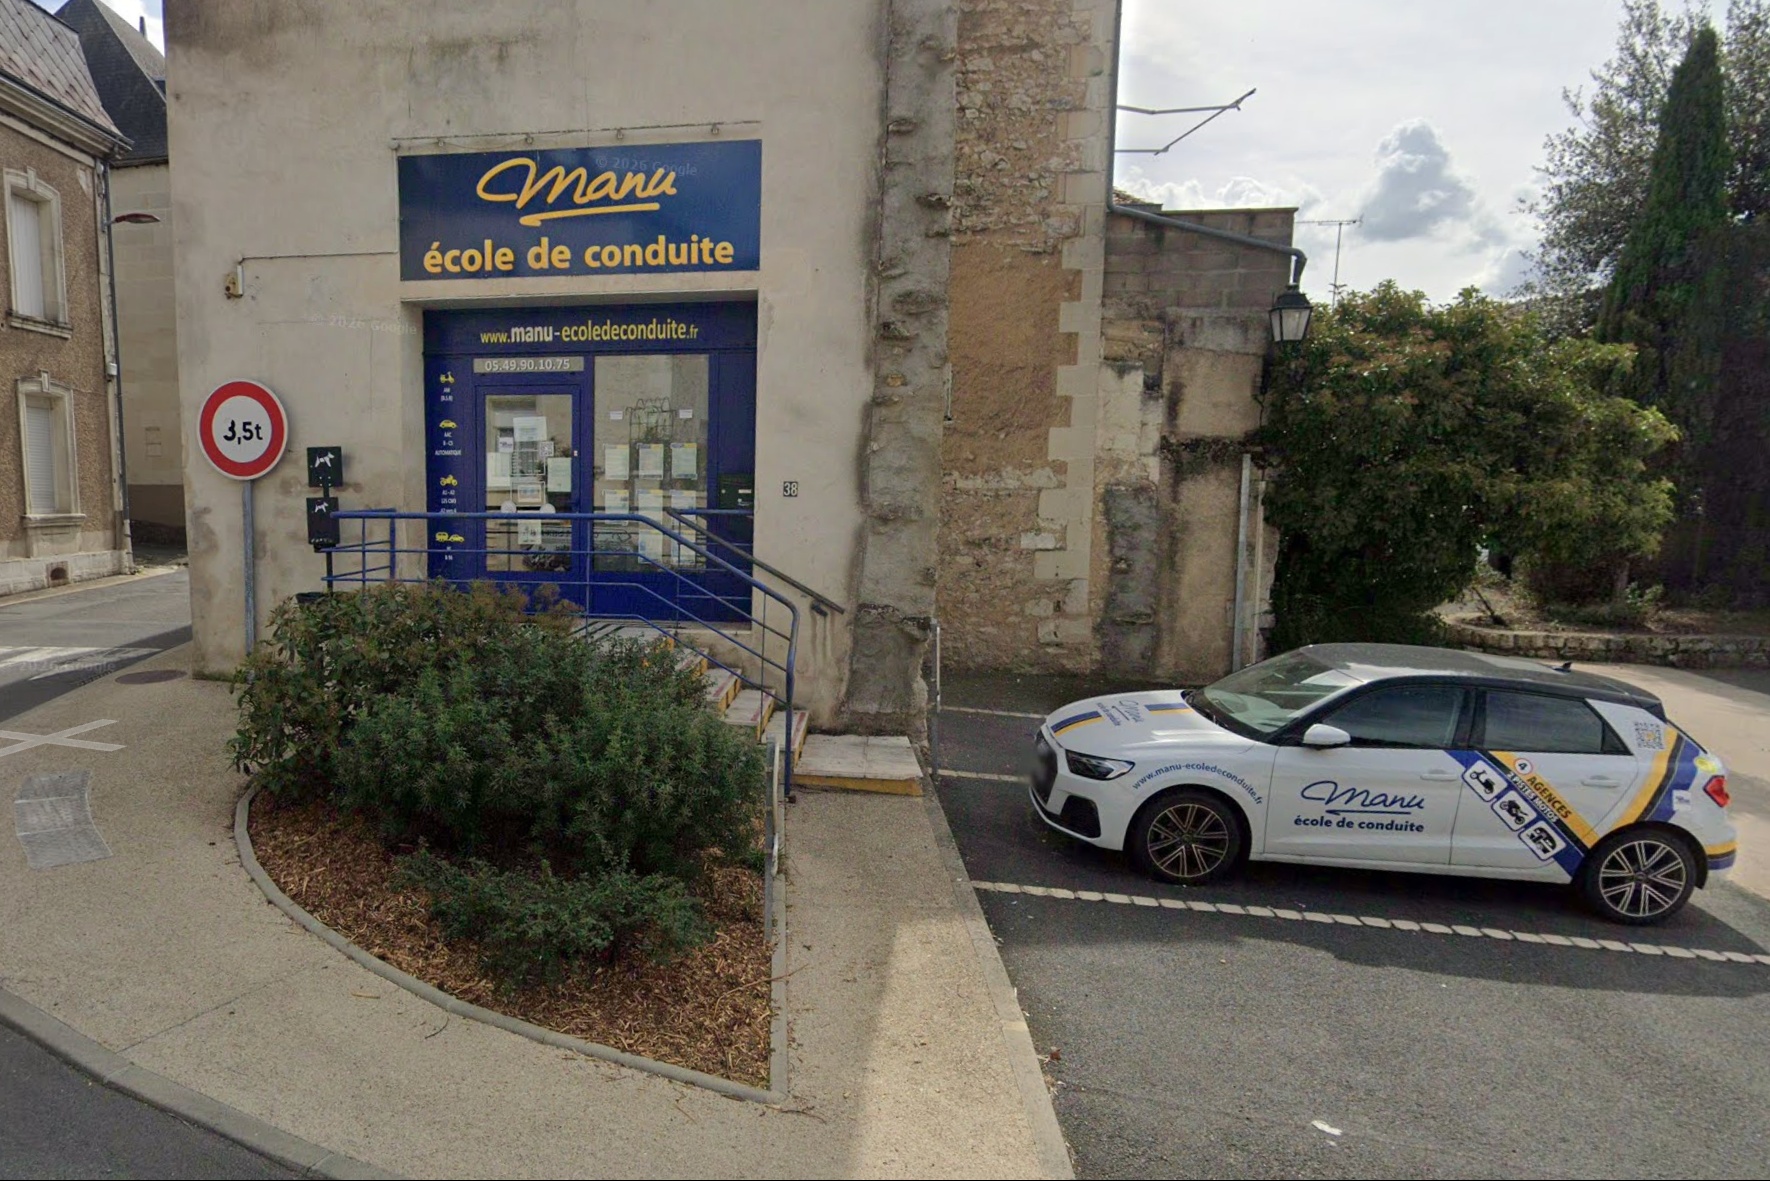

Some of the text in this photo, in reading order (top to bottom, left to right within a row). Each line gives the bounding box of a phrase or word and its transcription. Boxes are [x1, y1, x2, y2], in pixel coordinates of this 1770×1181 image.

[476, 157, 677, 210] Manu
[423, 234, 735, 274] école de conduite
[480, 318, 699, 344] www.manu-ecoledeconduite.fr
[484, 358, 570, 372] 05.49.90.10.75
[783, 482, 798, 496] 38
[1518, 762, 1528, 771] 4
[1132, 762, 1263, 805] www.manu-ecoledeconduite.fr
[1301, 780, 1425, 809] Manu
[1526, 776, 1572, 819] AGENCES
[1532, 795, 1559, 822] MOTOS
[1294, 815, 1425, 833] école de conduite
